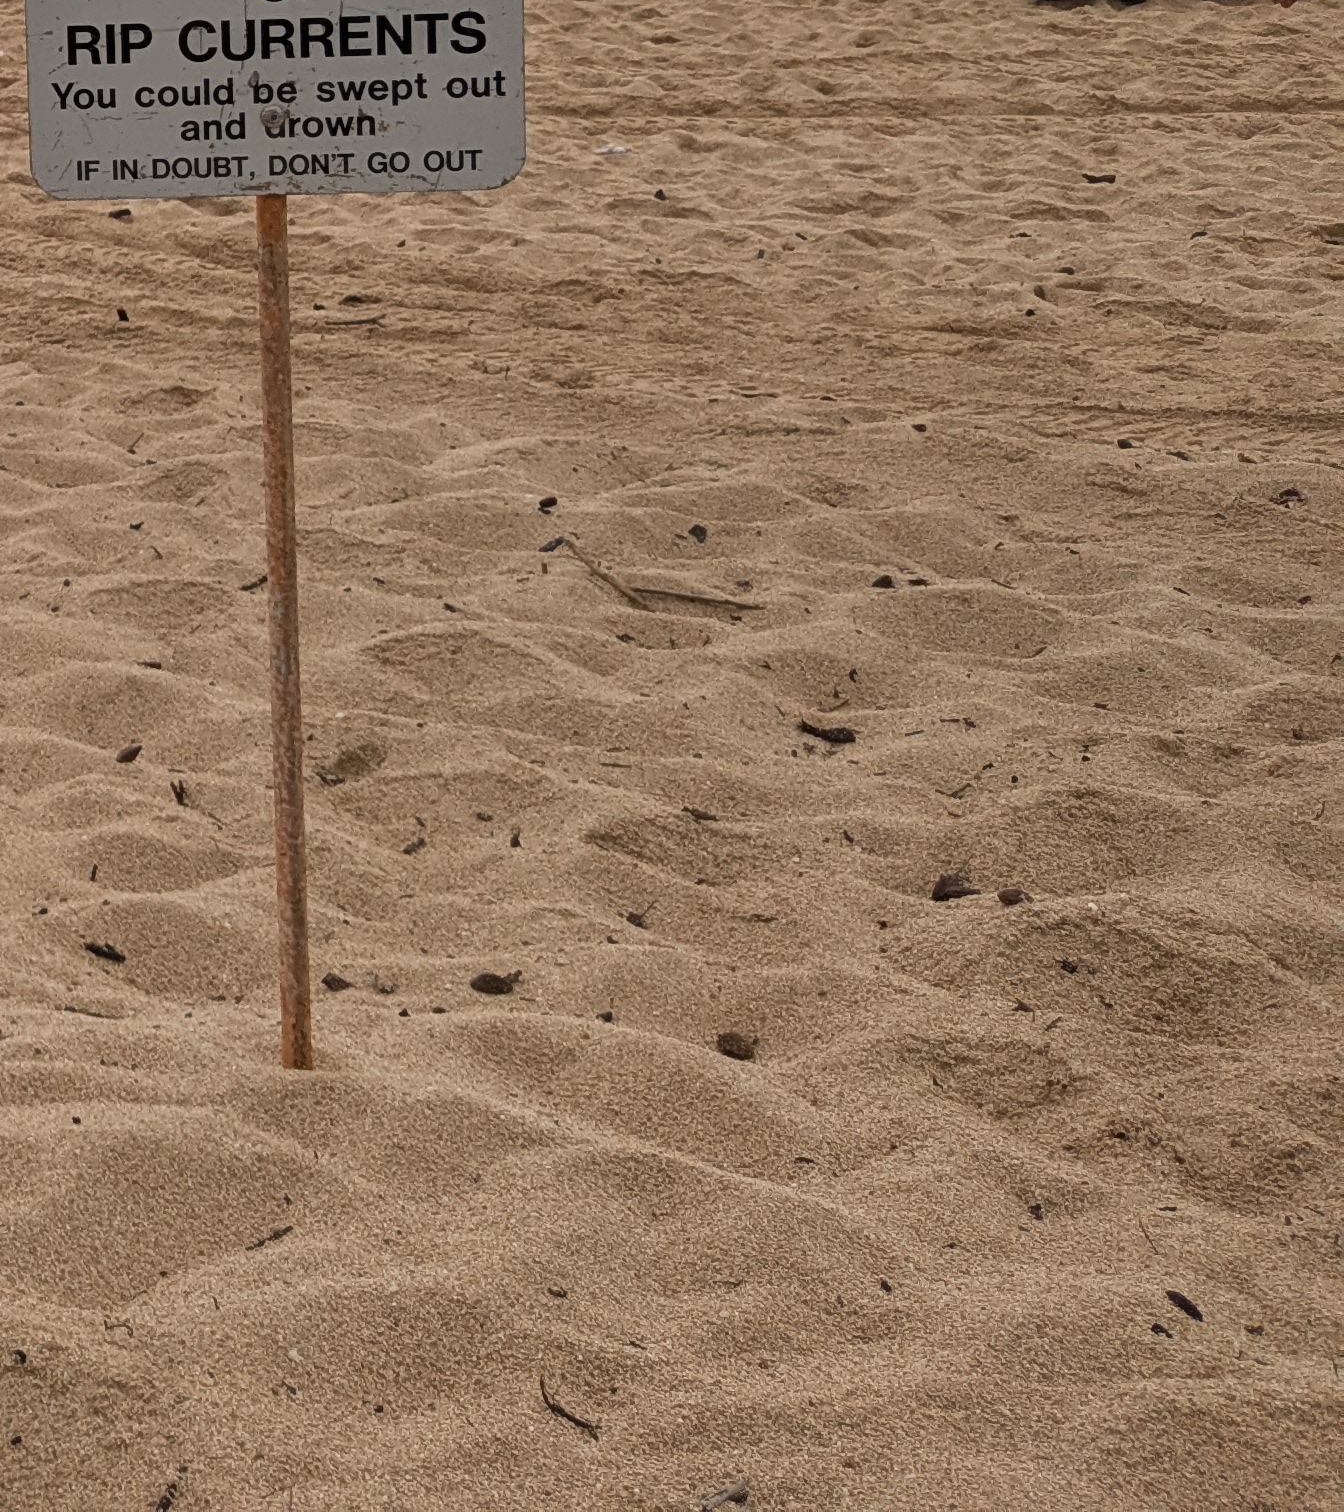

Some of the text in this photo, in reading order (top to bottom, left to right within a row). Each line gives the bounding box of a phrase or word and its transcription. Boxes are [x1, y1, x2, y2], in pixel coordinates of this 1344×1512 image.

[66, 11, 487, 66] RIP CURRENTS
[51, 70, 506, 110] You could be swept out
[180, 112, 246, 142] and
[77, 150, 483, 181] IF IN DOUBT, DON'T GO OUT
